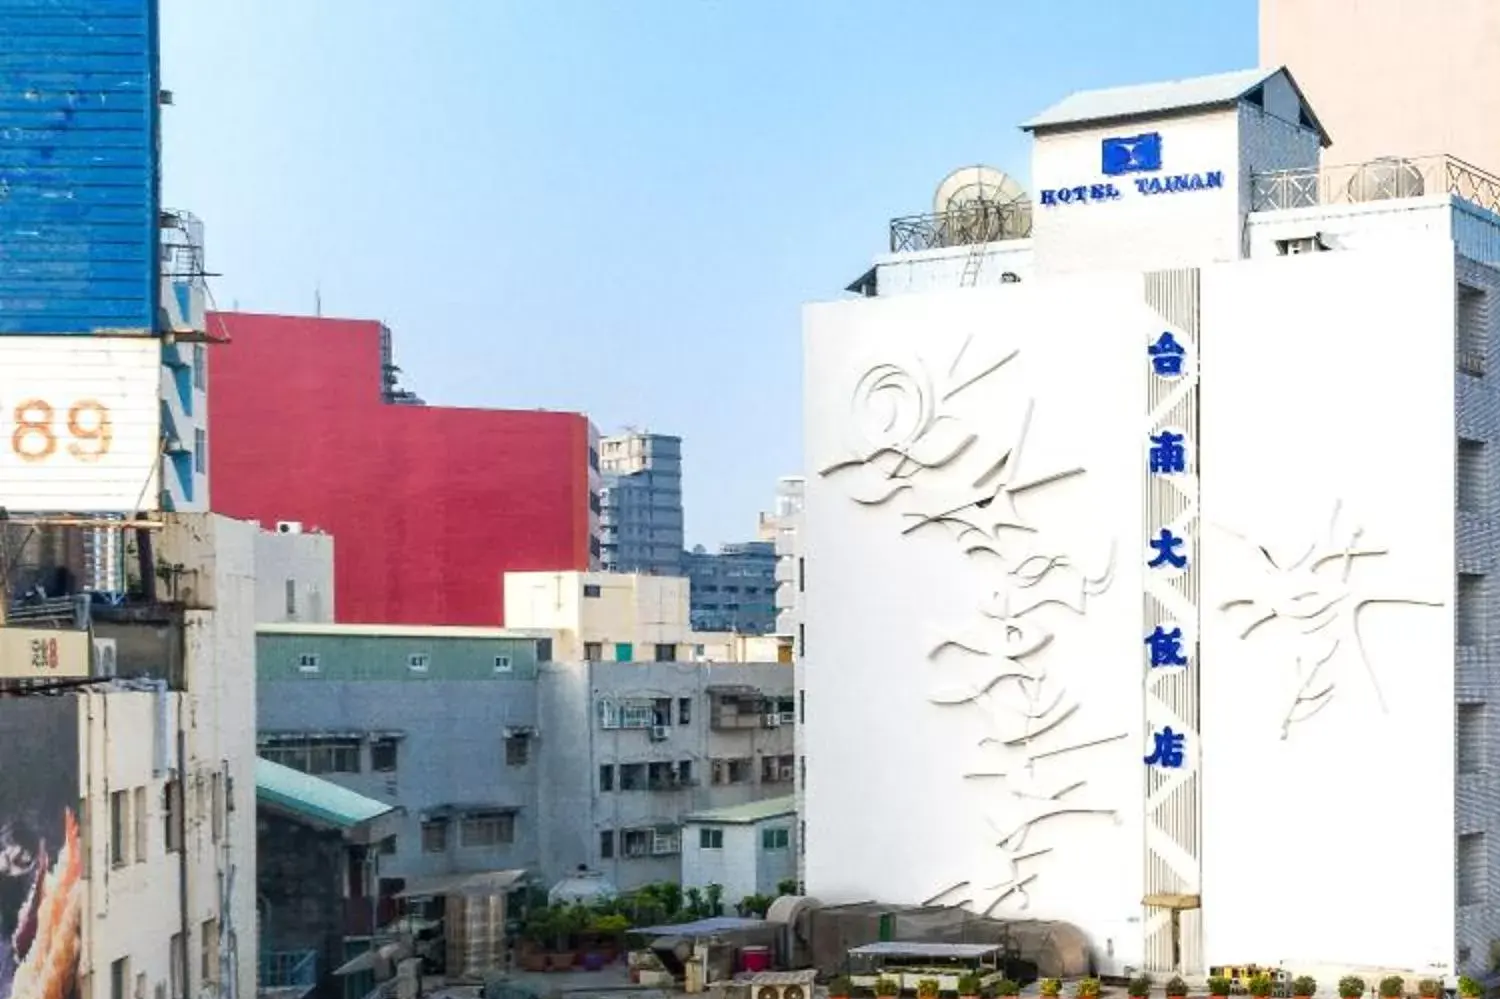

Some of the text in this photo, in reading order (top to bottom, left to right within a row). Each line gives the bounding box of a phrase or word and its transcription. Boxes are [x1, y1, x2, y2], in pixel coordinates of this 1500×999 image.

[1040, 171, 1224, 206] HOTEL TAINAN
[1143, 331, 1189, 769] 台南大飯店
